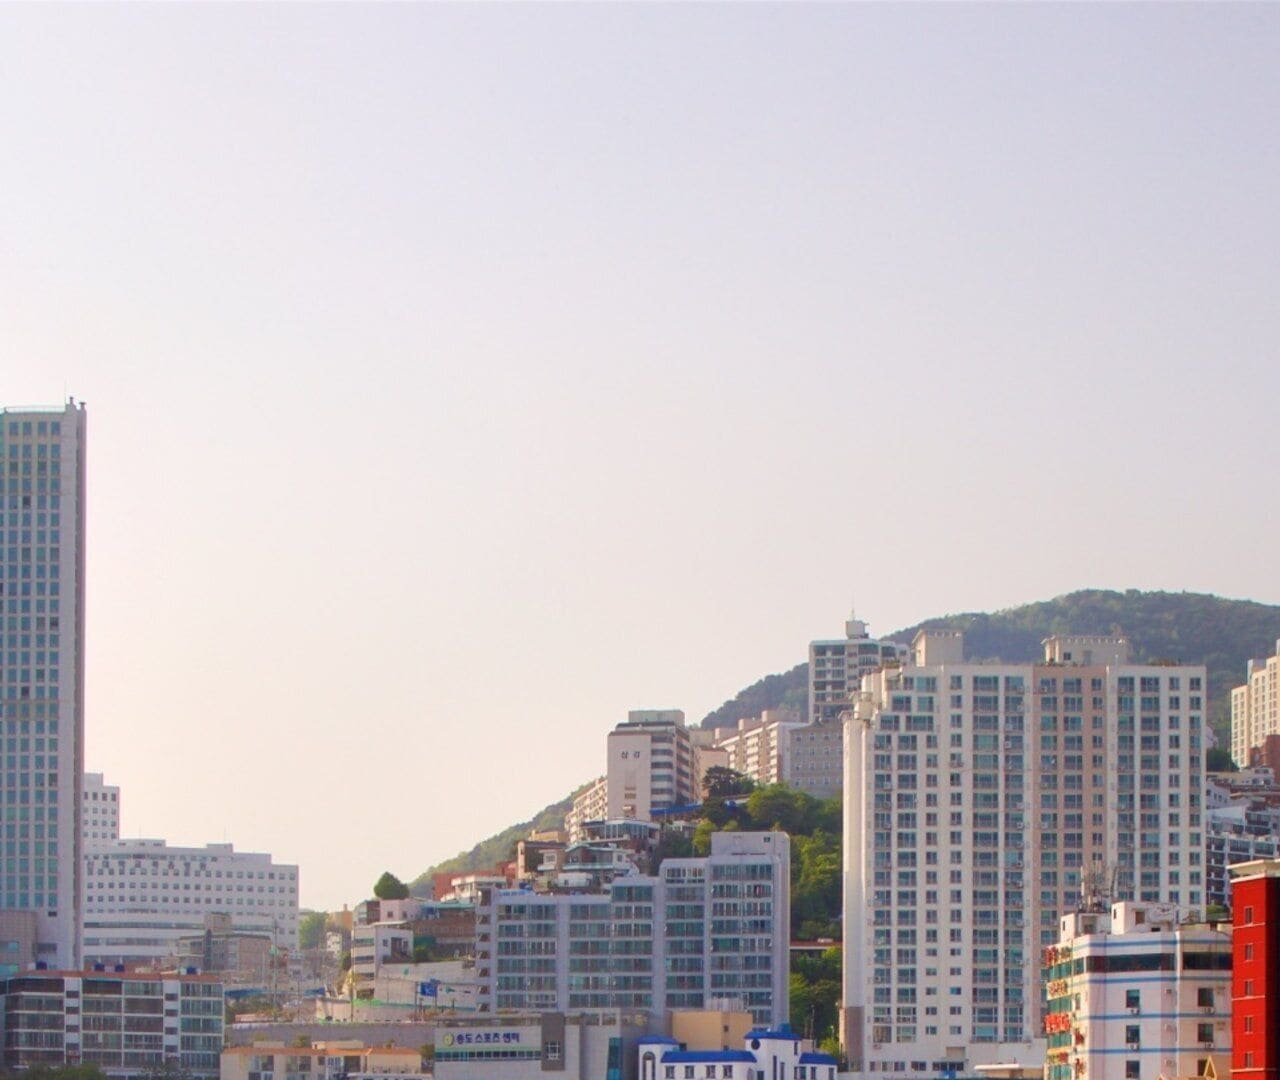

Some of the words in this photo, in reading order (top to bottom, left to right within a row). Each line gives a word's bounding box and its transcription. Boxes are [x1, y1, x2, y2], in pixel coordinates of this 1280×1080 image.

[456, 1032, 473, 1044] 송도
[475, 1032, 500, 1044] 스포츠
[502, 1031, 520, 1044] 센터
